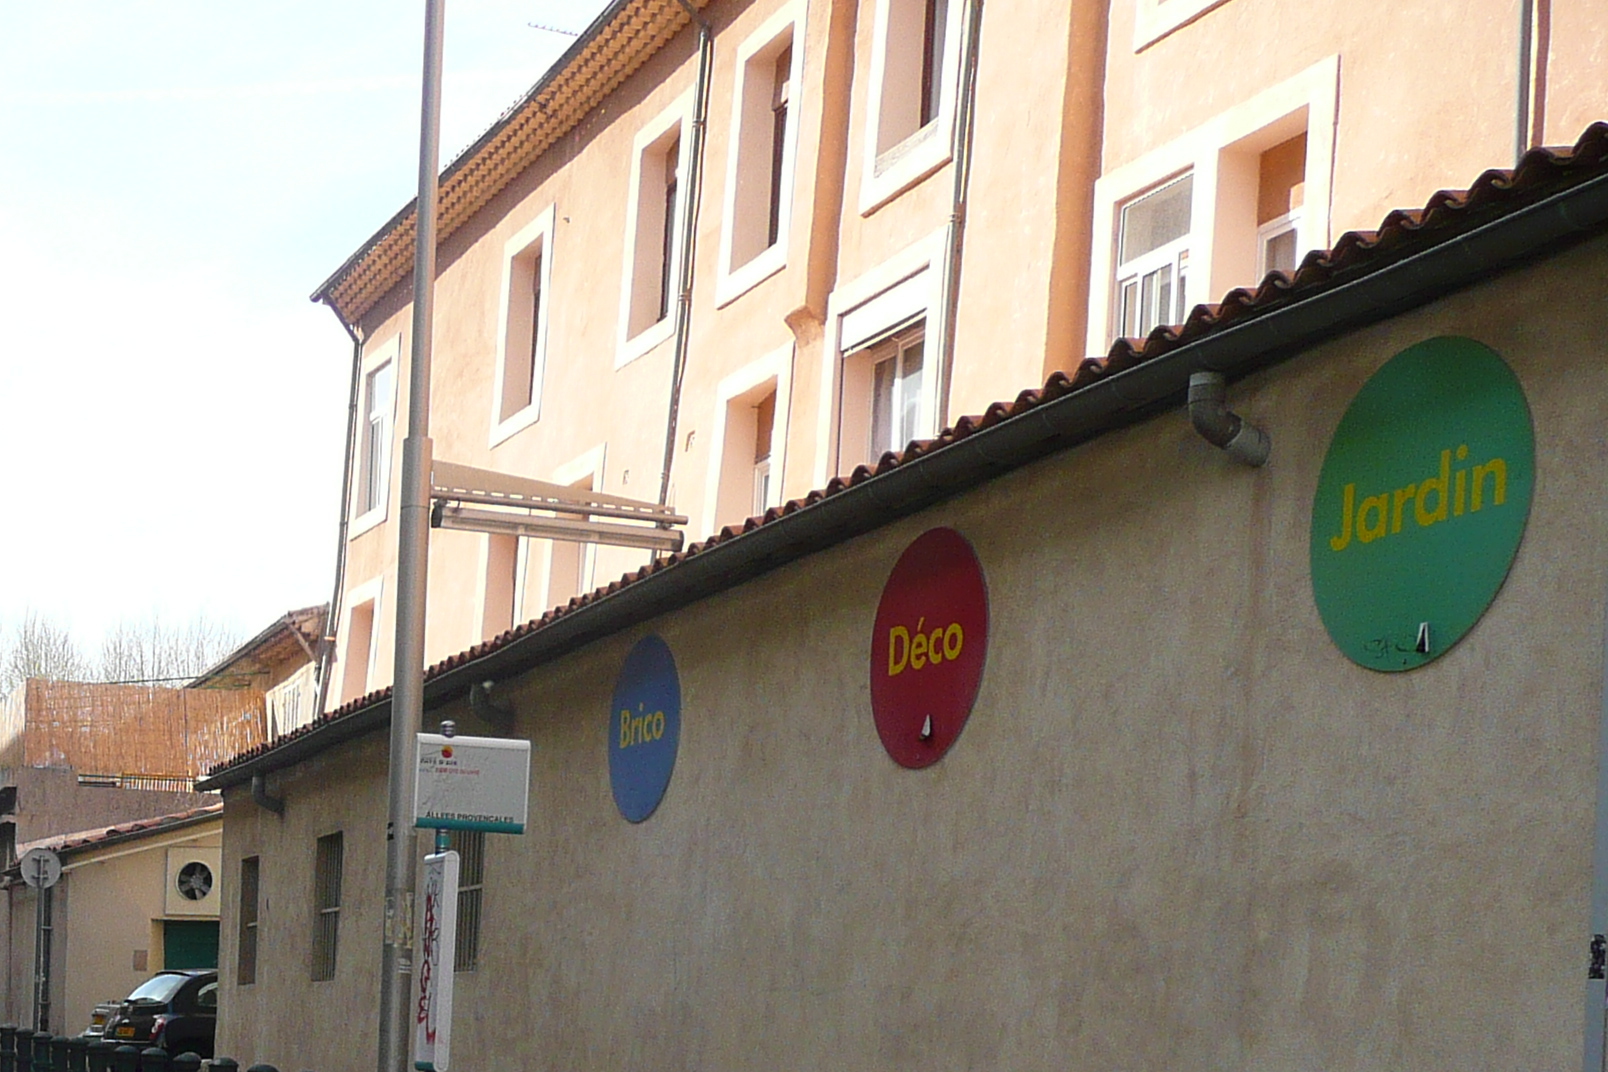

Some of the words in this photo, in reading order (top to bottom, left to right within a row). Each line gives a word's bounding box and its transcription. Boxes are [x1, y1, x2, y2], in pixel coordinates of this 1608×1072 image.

[1330, 444, 1507, 551] Jardin
[888, 616, 964, 676] Déco
[619, 702, 665, 749] Brico
